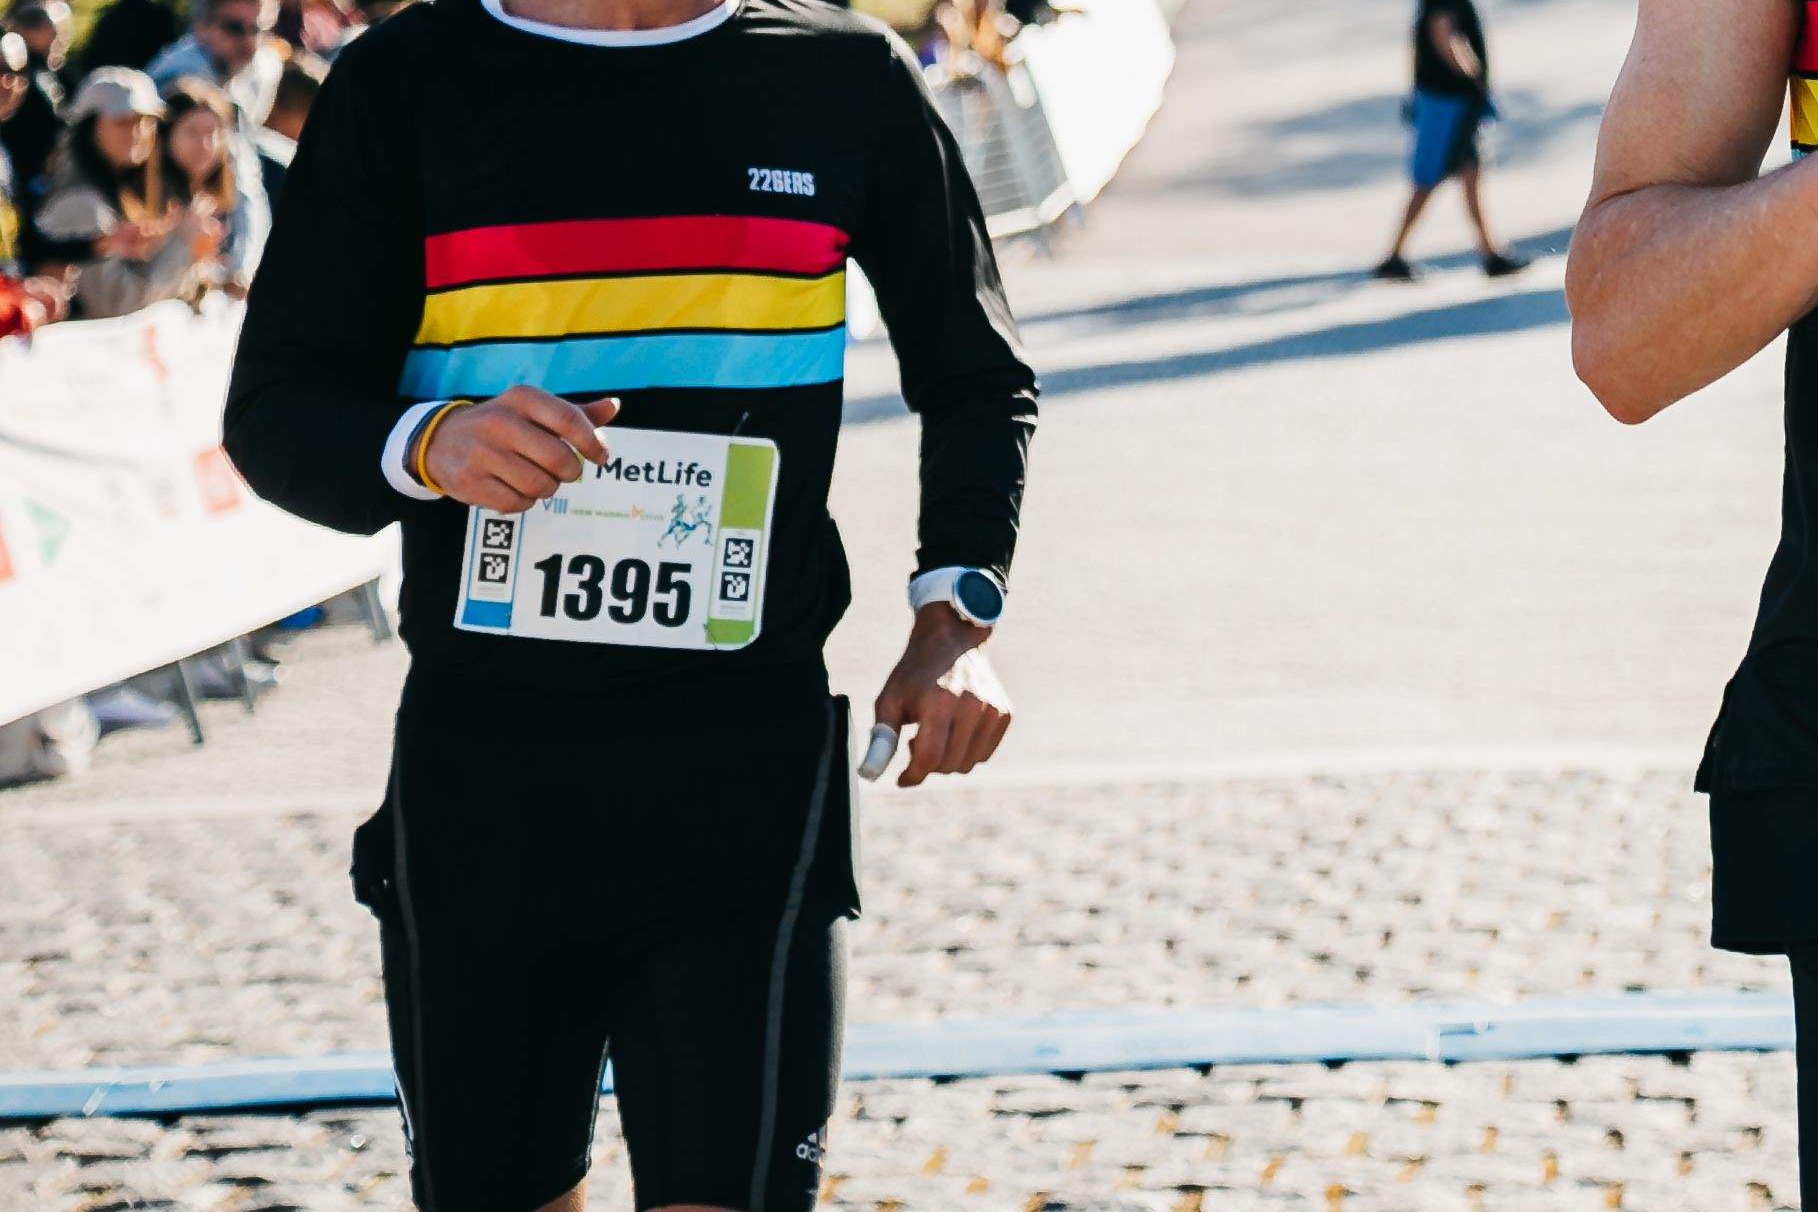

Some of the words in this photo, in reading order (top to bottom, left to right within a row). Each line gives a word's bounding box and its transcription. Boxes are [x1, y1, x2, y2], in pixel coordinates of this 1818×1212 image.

[747, 167, 815, 196] 226ERS
[595, 457, 712, 487] MetLife
[534, 554, 692, 627] 1395
